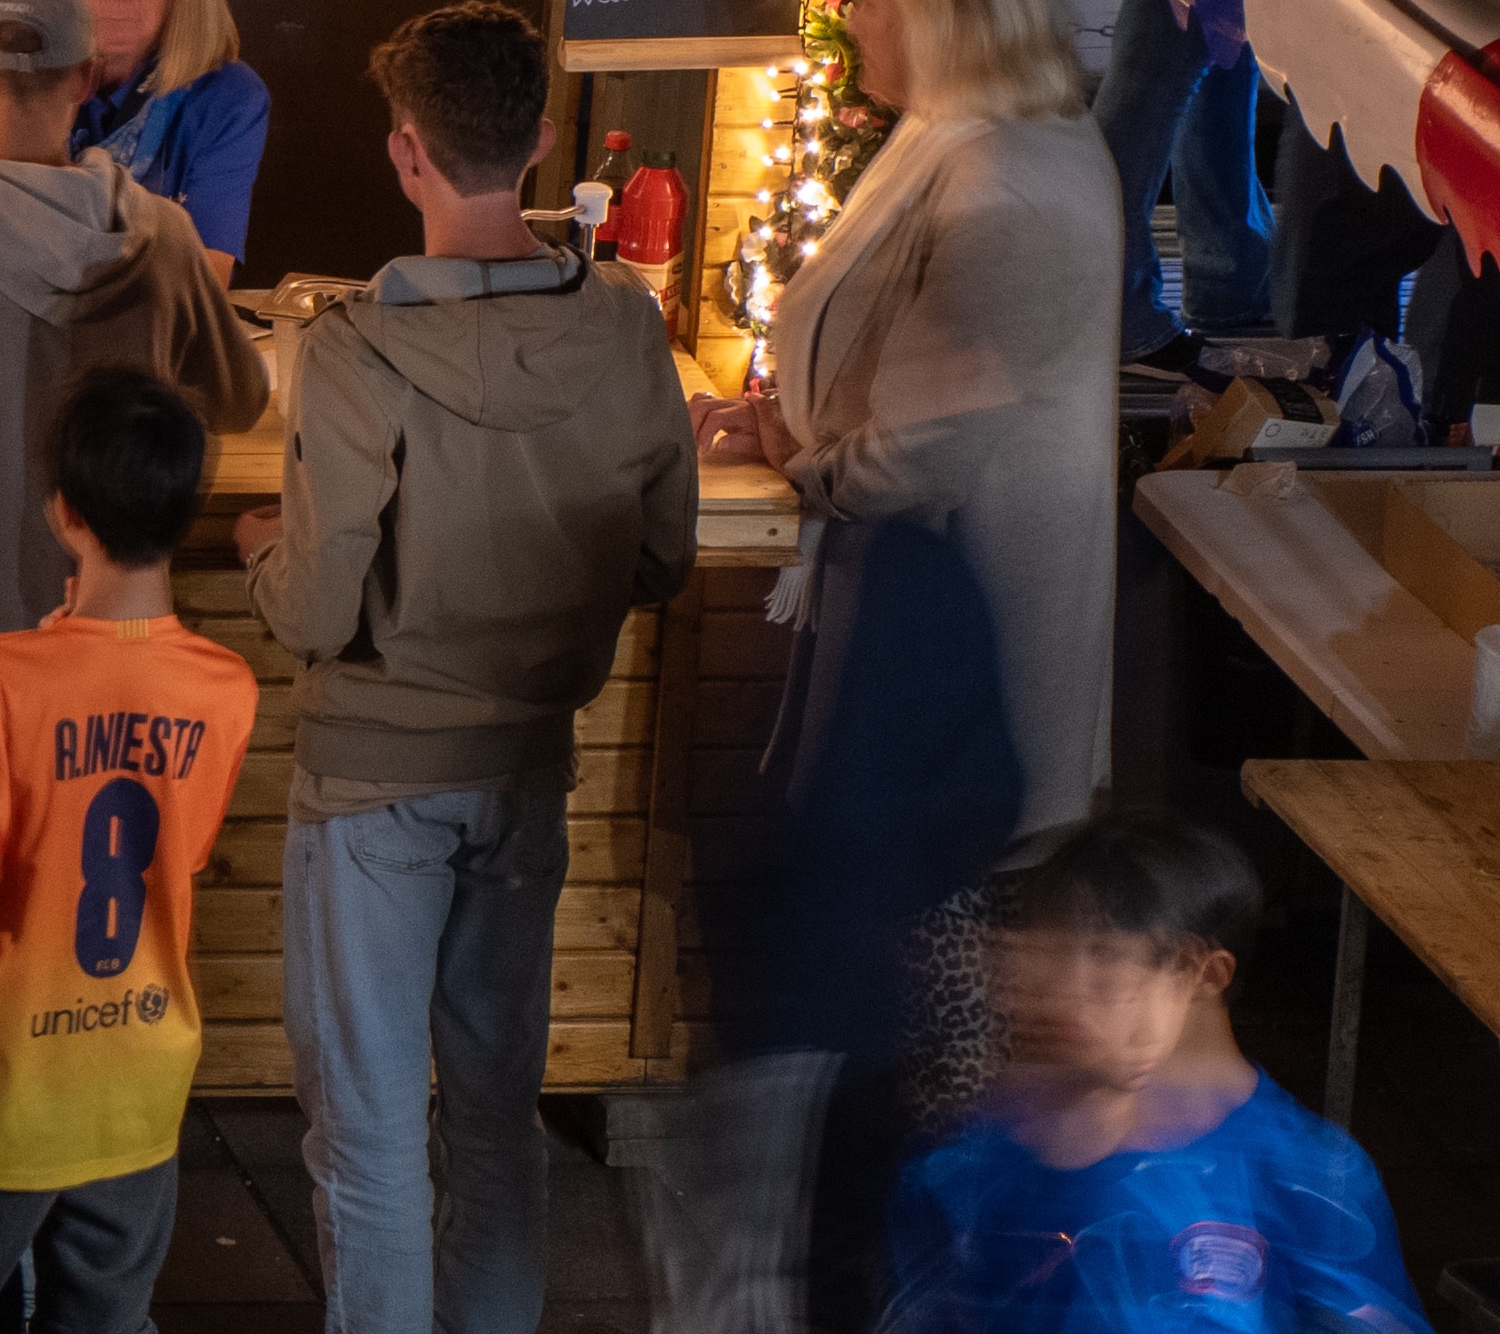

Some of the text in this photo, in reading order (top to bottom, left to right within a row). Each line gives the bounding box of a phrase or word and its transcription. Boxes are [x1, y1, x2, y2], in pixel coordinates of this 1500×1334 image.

[55, 711, 206, 781] A.INIESTA
[74, 777, 161, 980] 8
[30, 987, 135, 1039] unicef
